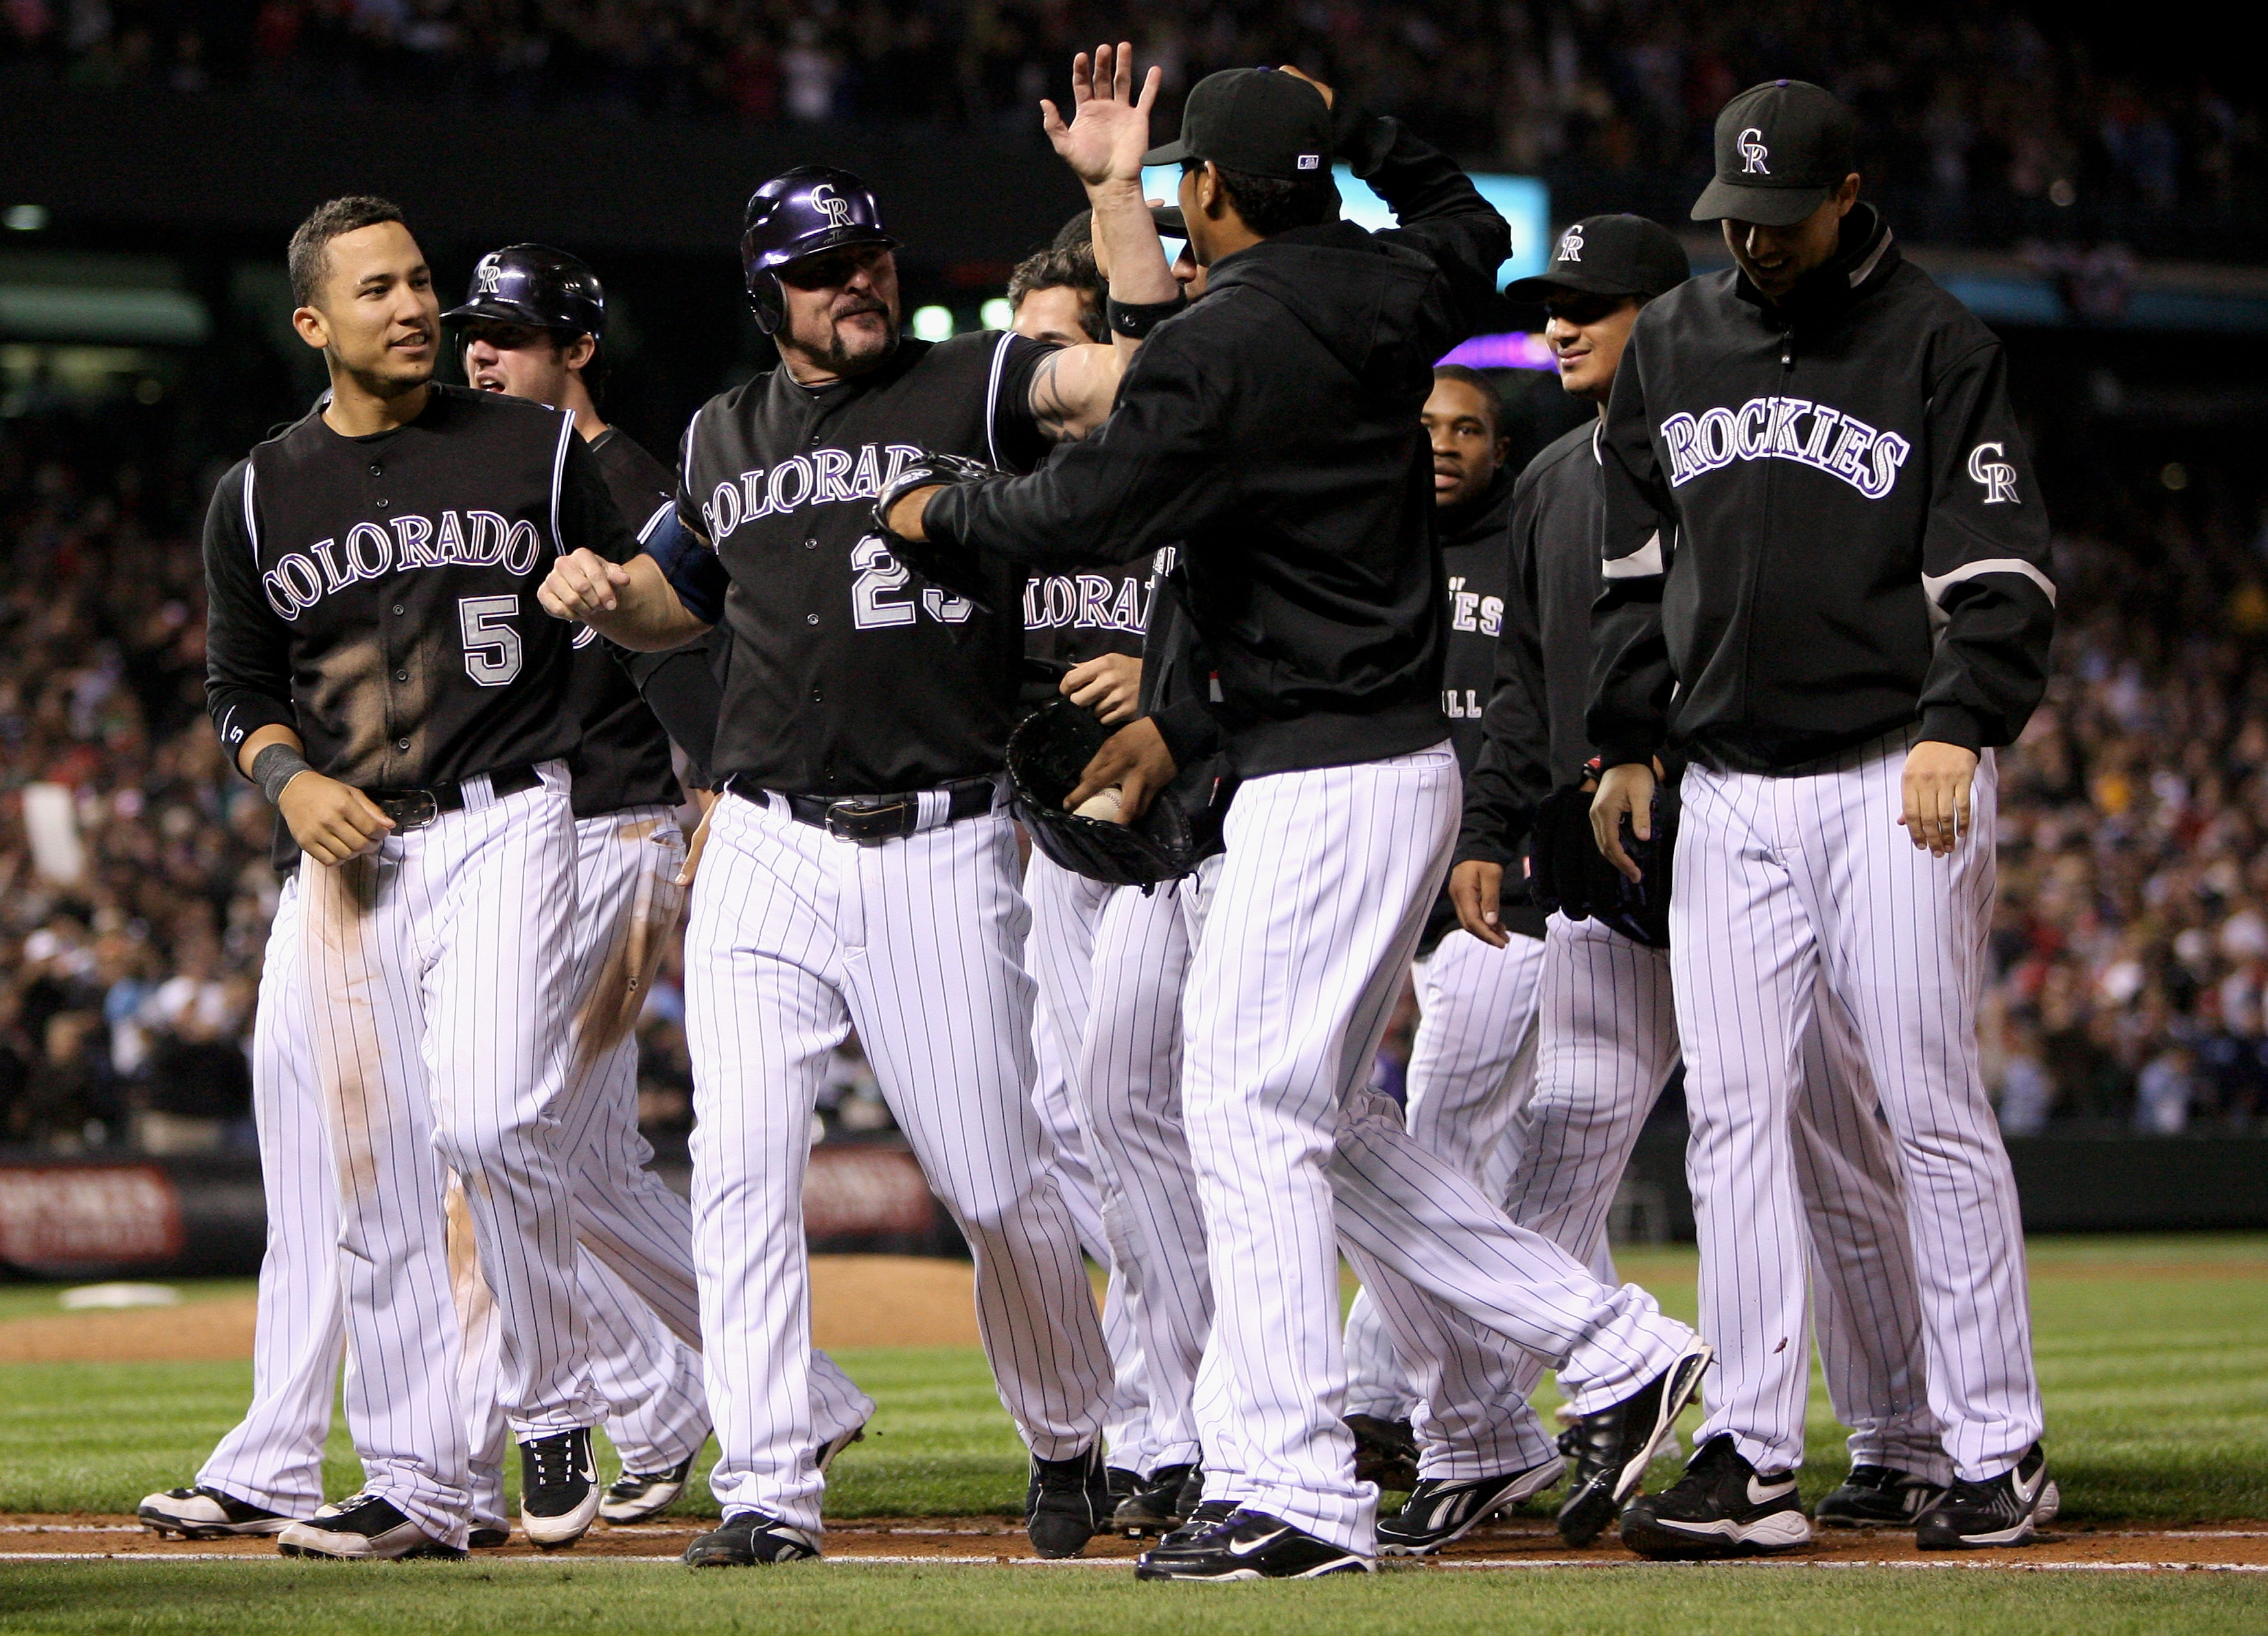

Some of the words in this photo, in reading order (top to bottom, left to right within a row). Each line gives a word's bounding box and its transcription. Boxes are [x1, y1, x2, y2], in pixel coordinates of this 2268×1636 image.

[702, 444, 924, 555] COLORAD
[1660, 397, 1911, 500] ROCKIES
[262, 511, 540, 621] COLORADO
[1023, 573, 1155, 636] LORA
[459, 594, 522, 687] 5
